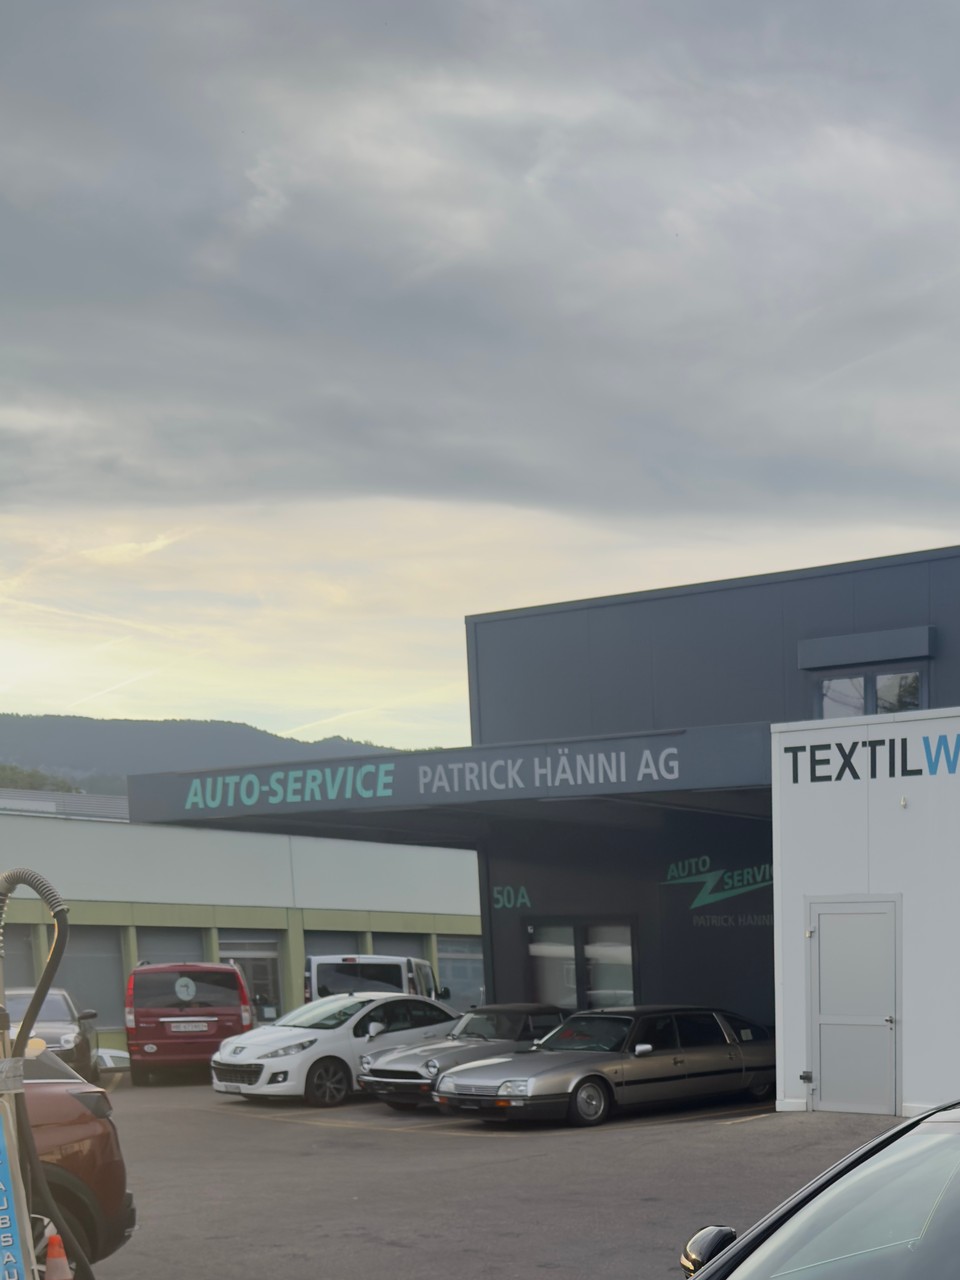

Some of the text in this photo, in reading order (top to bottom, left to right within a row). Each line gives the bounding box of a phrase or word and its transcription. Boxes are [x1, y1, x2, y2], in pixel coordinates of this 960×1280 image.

[185, 747, 680, 809] AUTO-SERVICE PATRICK HÄNNI AG
[666, 856, 711, 881] AUTO
[723, 863, 774, 890] SERVI
[493, 885, 532, 909] 50A
[692, 914, 736, 927] PATRICK
